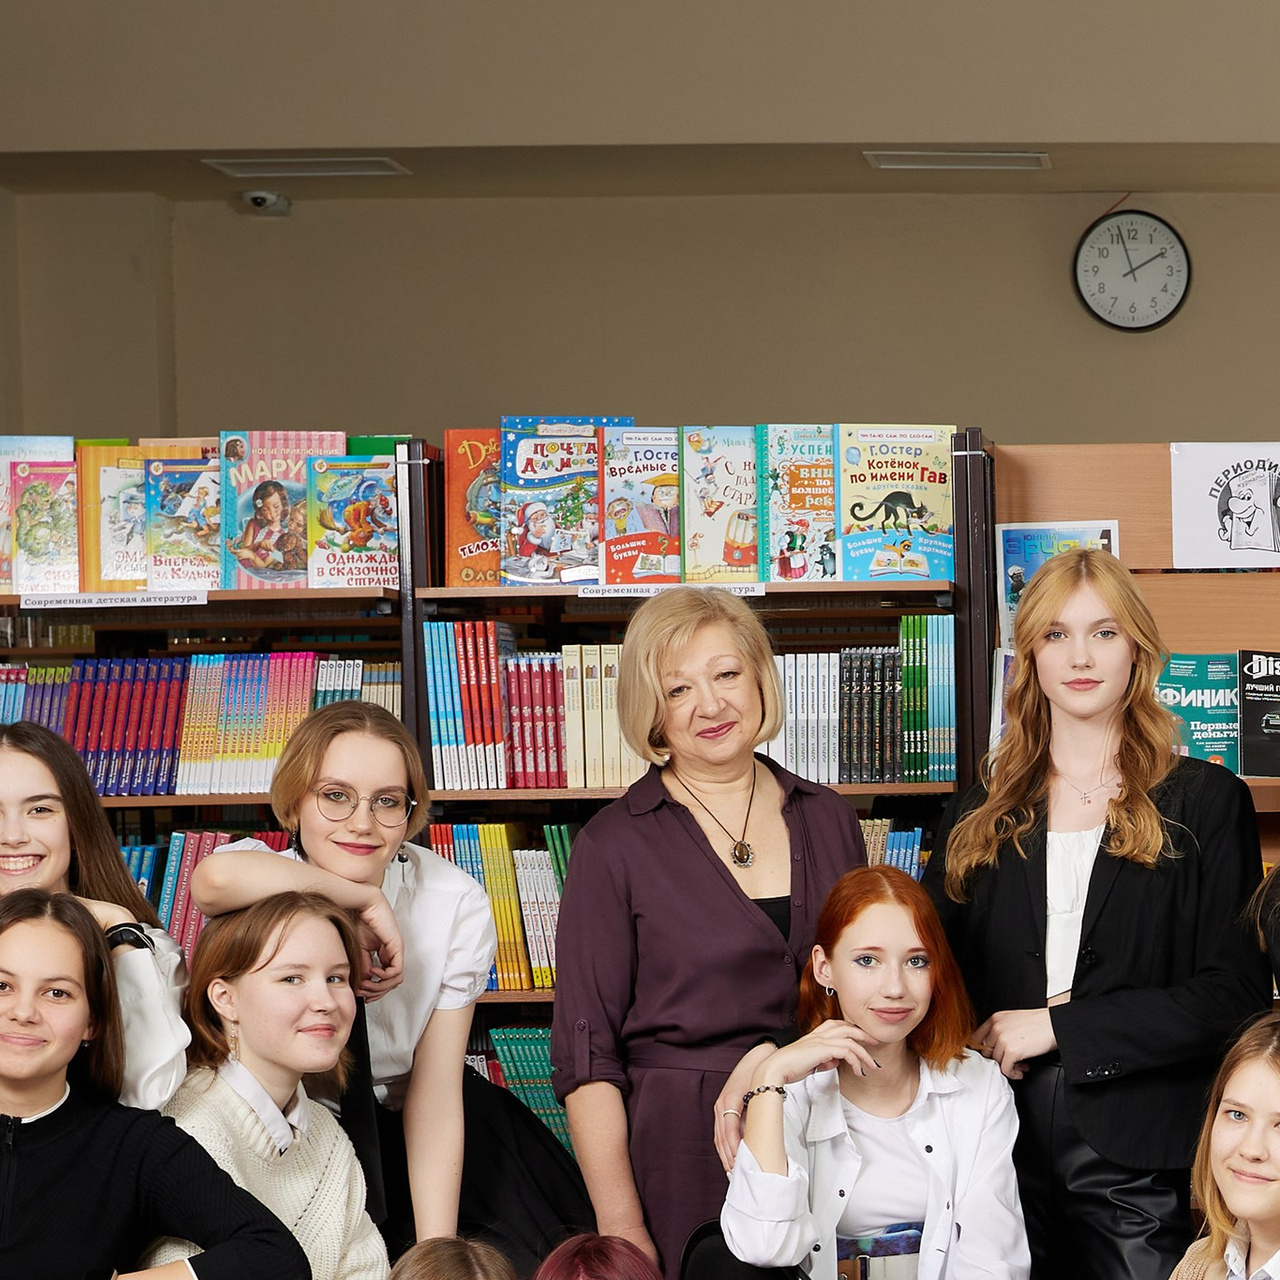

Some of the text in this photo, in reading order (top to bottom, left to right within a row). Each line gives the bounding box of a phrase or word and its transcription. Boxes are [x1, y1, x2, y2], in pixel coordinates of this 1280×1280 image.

[1110, 234, 1120, 245] 11
[1127, 229, 1138, 240] 12
[1148, 234, 1153, 245] 1
[1098, 247, 1109, 259] 10
[1160, 247, 1167, 259] 2
[1092, 265, 1099, 277] 9
[1166, 266, 1174, 277] 3
[1098, 282, 1105, 294] 8
[1161, 282, 1168, 293] 4
[1110, 297, 1118, 308] 7
[1129, 302, 1137, 314] 6
[1150, 297, 1157, 308] 5
[721, 438, 746, 447] Маша
[533, 442, 598, 456] ПОЧТА
[868, 457, 919, 470] Котёнок
[850, 470, 914, 484] по имени
[920, 467, 948, 485] Гав
[873, 482, 899, 491] другие
[901, 483, 929, 491] сказки
[610, 539, 646, 553] Большие
[847, 536, 883, 551] Большие
[918, 536, 953, 549] Крупные
[613, 549, 639, 562] буквы
[850, 547, 875, 558] буквы
[316, 569, 324, 577] В
[347, 577, 399, 586] СТРАНЕ
[582, 586, 648, 597] Современная
[24, 593, 198, 607] Современная детская литература
[1245, 682, 1274, 692] ЛУЧШИЙ
[1155, 687, 1238, 708] ФИНИК
[1190, 721, 1238, 731] Первые
[1193, 730, 1238, 740] деньги
[170, 838, 181, 874] МАРУСИ
[175, 868, 188, 919] ПРИКЛЮЧЕНИЯ
[185, 839, 194, 866] МАРУСИ
